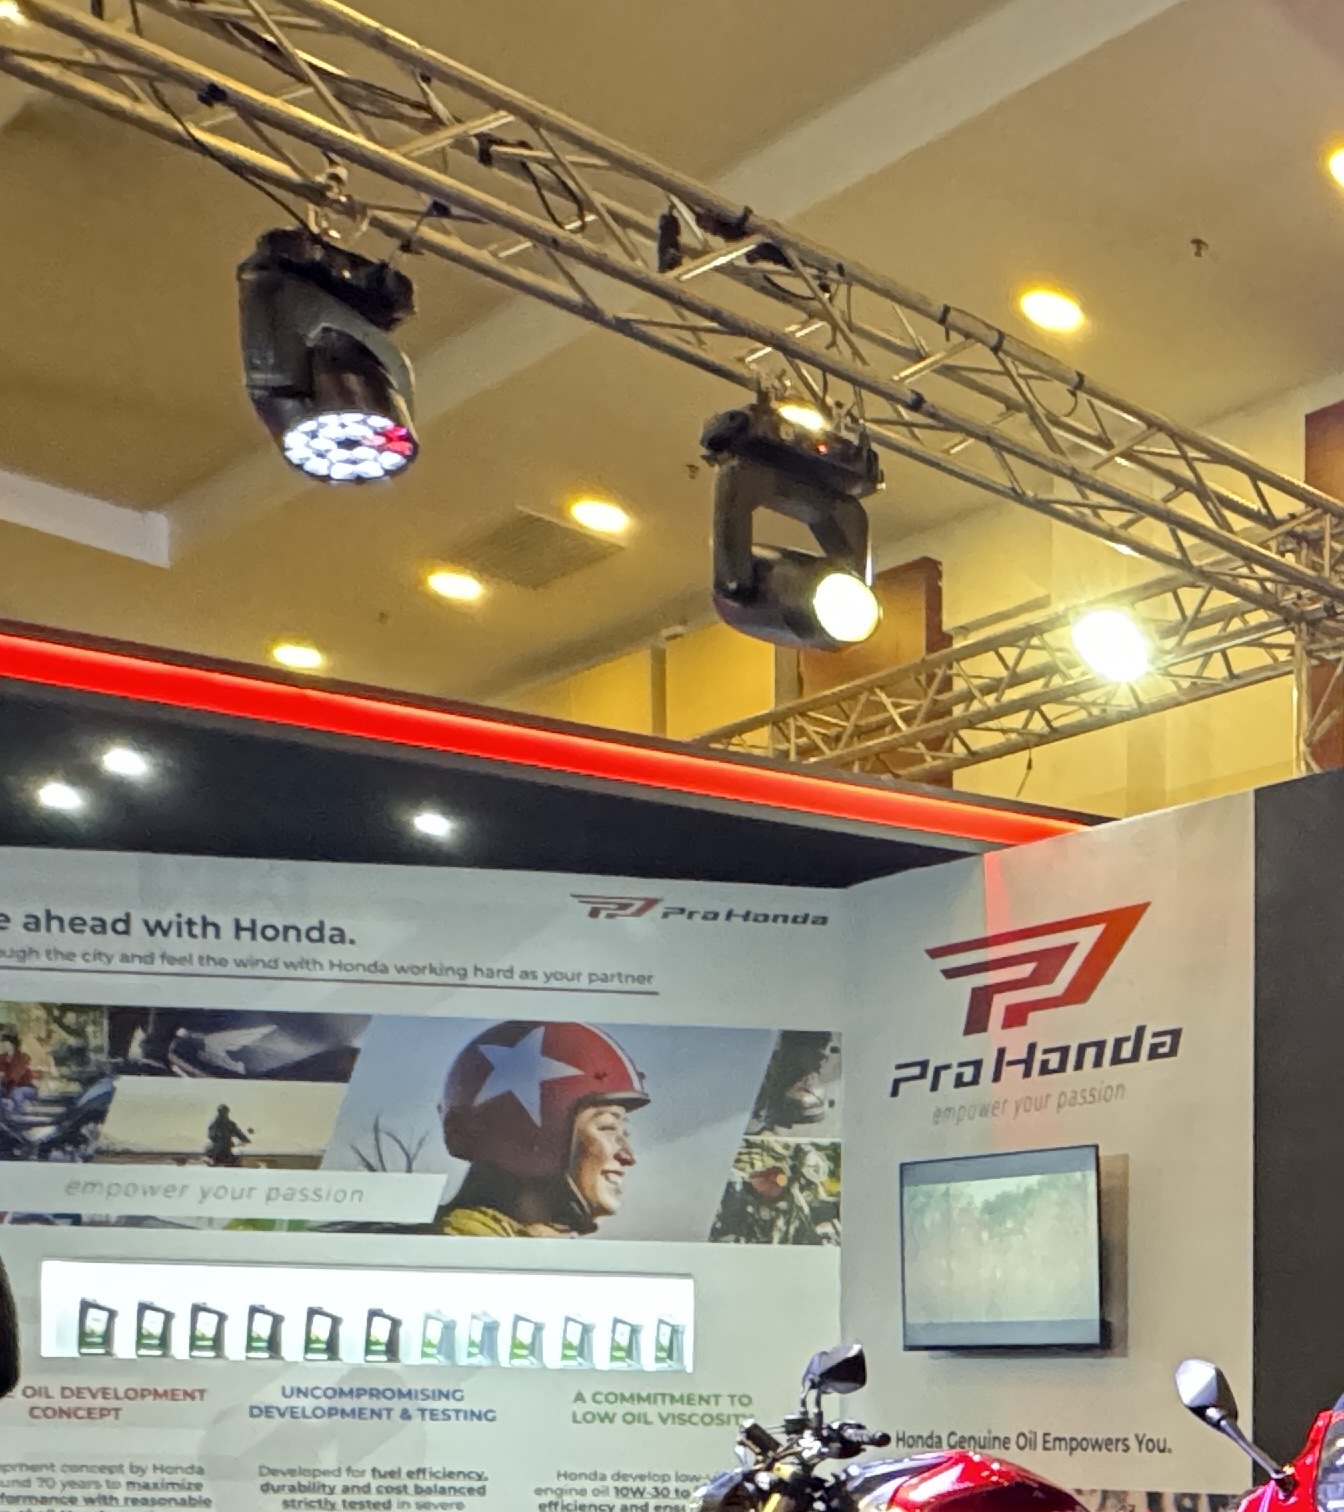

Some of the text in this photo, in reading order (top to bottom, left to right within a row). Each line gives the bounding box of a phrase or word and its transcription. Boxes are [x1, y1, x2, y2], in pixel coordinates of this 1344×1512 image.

[23, 909, 130, 936] ahead
[143, 912, 221, 940] with
[233, 917, 356, 946] Honda.
[46, 948, 77, 962] the
[81, 949, 113, 965] city
[119, 951, 155, 966] and
[159, 951, 193, 966] feel
[199, 953, 229, 968] the
[233, 954, 279, 969] wind
[284, 956, 324, 971] with
[328, 959, 389, 975] Honda
[394, 960, 468, 981] working
[473, 964, 514, 980] hard
[518, 969, 538, 981] as
[542, 970, 583, 987] your
[588, 969, 653, 988] partner
[931, 1081, 1126, 1126] empower your passion
[65, 1179, 364, 1205] empower your passion
[22, 1385, 52, 1400] OIL
[61, 1386, 206, 1402] DEVELOPMENT
[282, 1386, 464, 1402] UNCOMPROMISING
[573, 1390, 753, 1408] A COMMITMENT TO
[29, 1405, 123, 1420] CONCEPT
[249, 1405, 497, 1422] DEVELOPMENT & TESTING
[572, 1411, 616, 1425] LOW
[622, 1411, 654, 1426] OIL
[895, 1430, 1172, 1455] Honda Genuine Oil Empowers You.
[129, 1462, 147, 1477] by
[153, 1463, 205, 1476] Honda
[258, 1465, 341, 1479] Developed
[371, 1467, 401, 1479] fuel
[557, 1470, 607, 1482] Honda
[611, 1470, 671, 1483] develop
[106, 1478, 121, 1489] to
[260, 1481, 486, 1496] durability and cost balanced
[534, 1487, 588, 1499] engine
[591, 1486, 609, 1498] oil
[675, 1487, 690, 1499] to
[83, 1493, 119, 1506] with
[124, 1494, 213, 1508] reasonable
[342, 1498, 392, 1510] tested
[415, 1500, 465, 1511] severe
